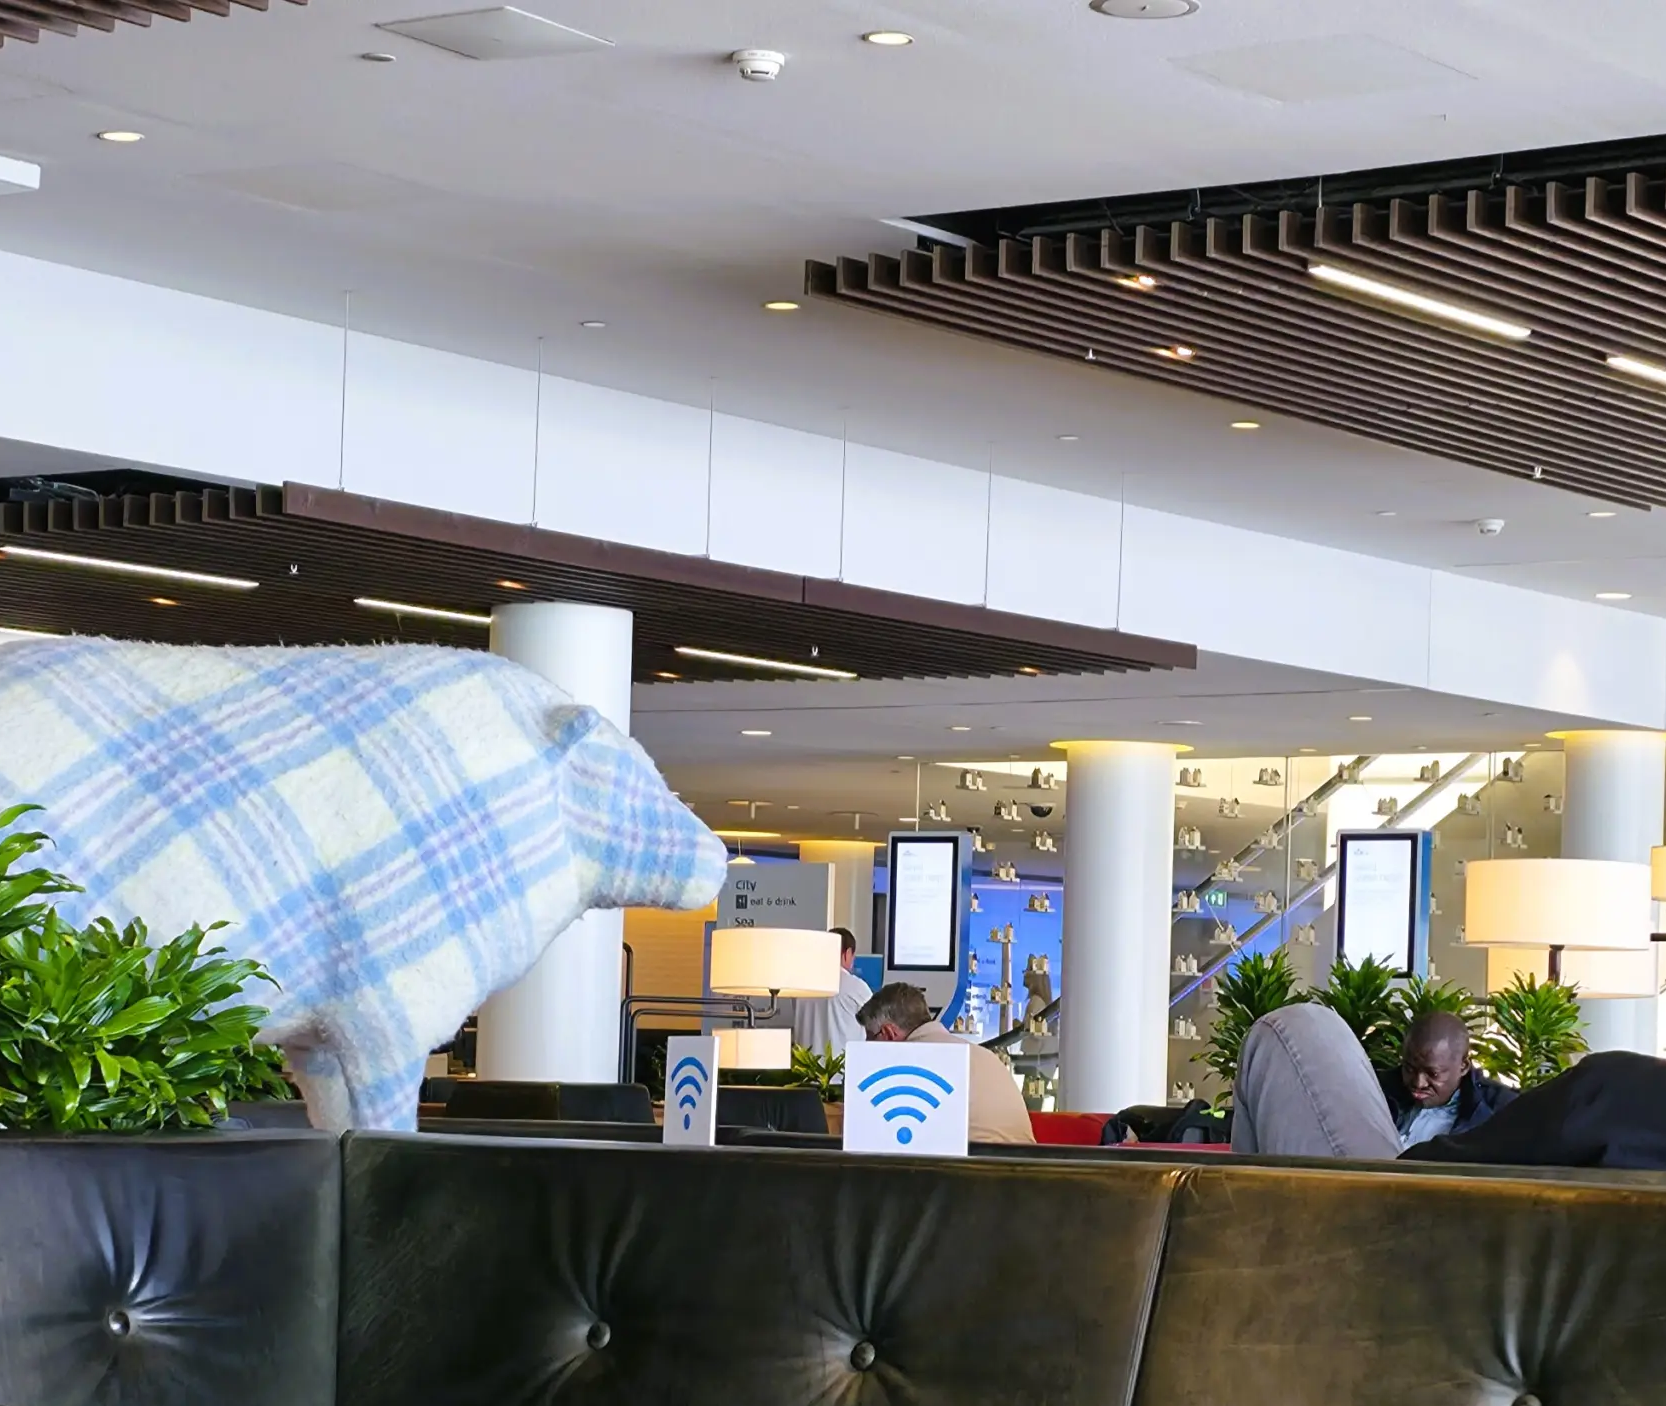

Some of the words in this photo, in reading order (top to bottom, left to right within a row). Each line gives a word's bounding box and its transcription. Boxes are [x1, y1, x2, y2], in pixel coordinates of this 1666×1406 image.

[735, 880, 757, 892] City
[750, 896, 764, 906] eat
[775, 895, 797, 906] drink
[734, 916, 755, 928] Sea
